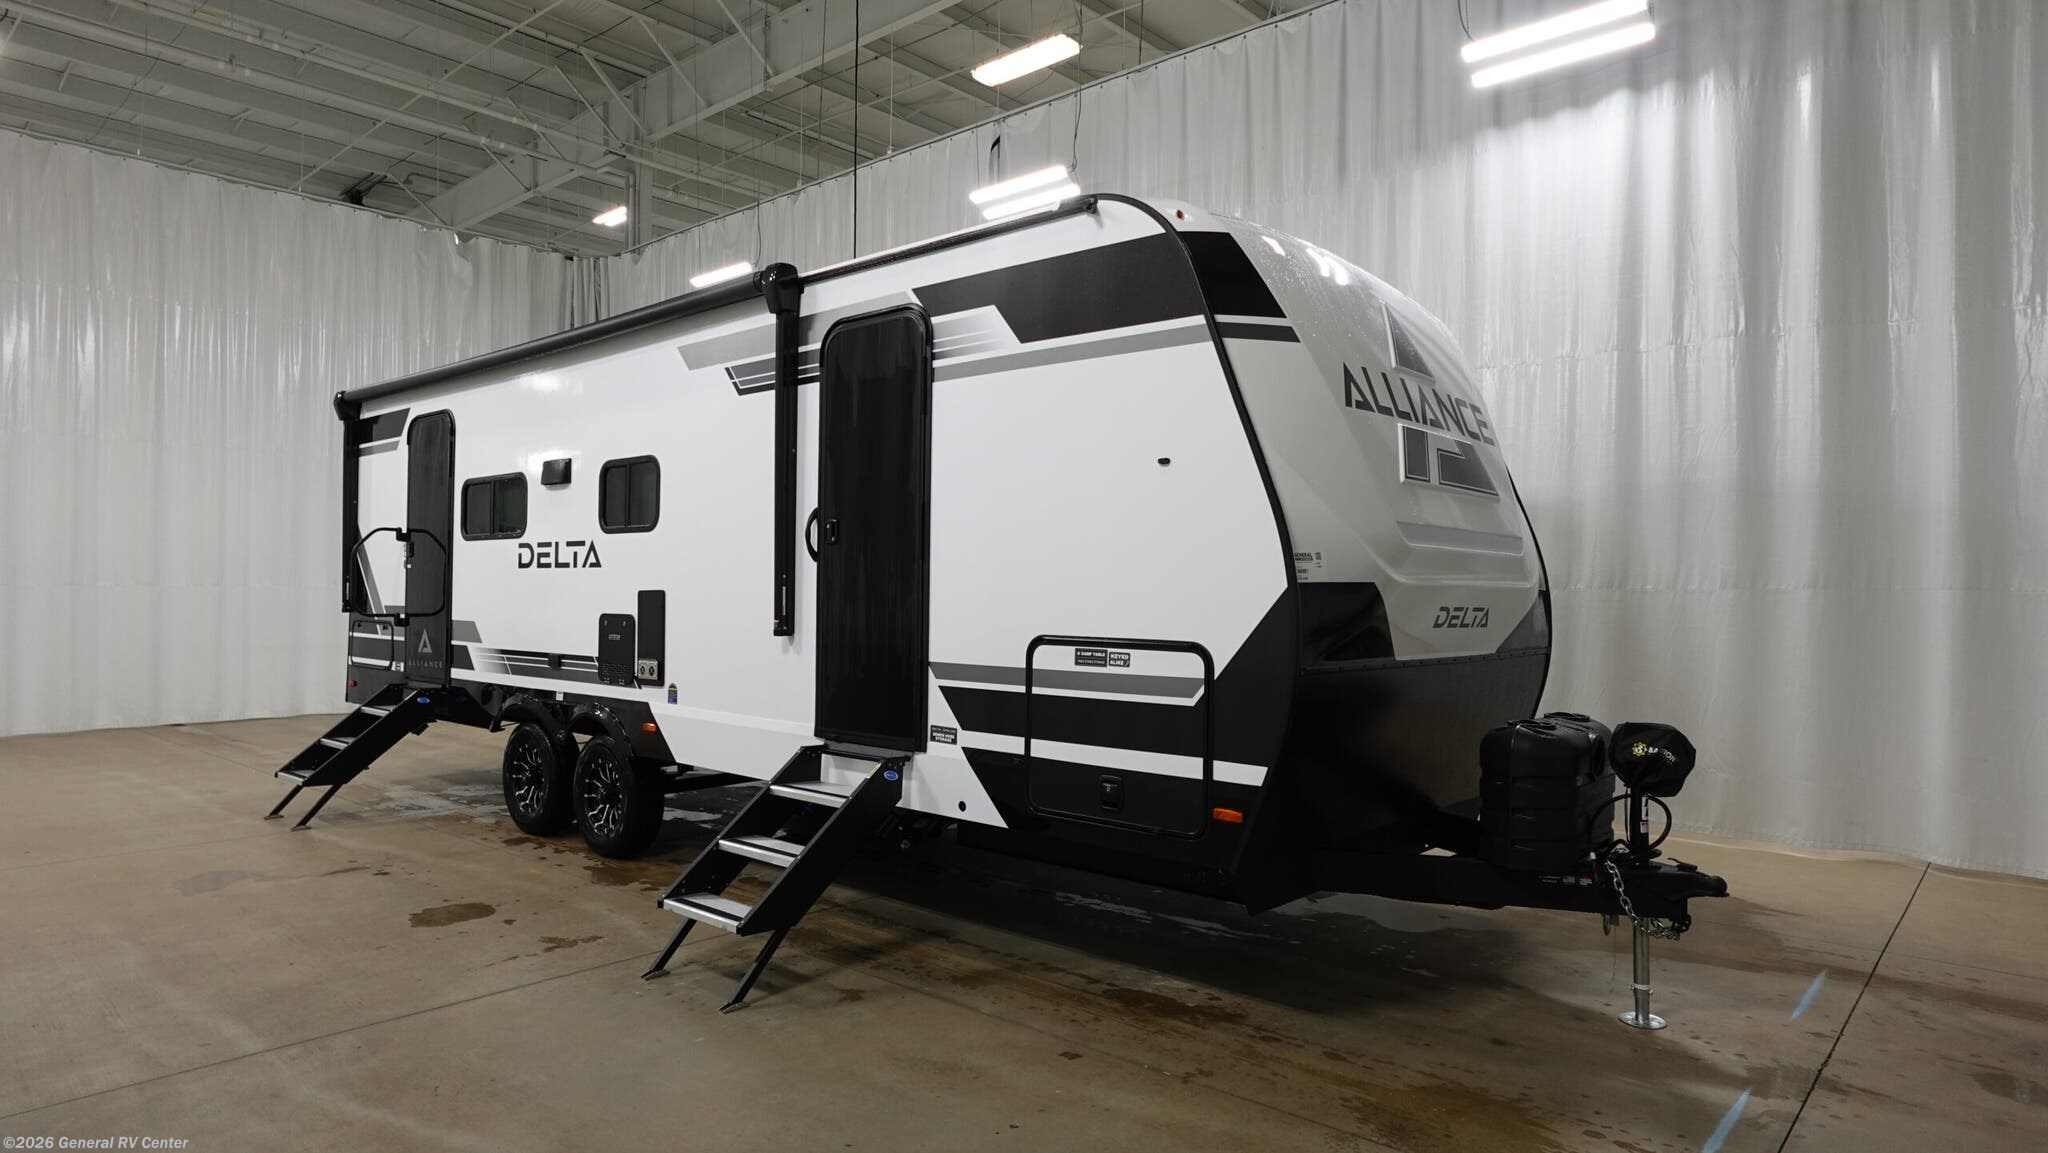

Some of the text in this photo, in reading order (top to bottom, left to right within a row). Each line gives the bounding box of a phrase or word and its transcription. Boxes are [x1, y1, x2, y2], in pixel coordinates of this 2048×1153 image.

[1343, 362, 1496, 447] ALLIANCE
[517, 540, 602, 569] DELTA
[1432, 606, 1490, 629] DELTA
